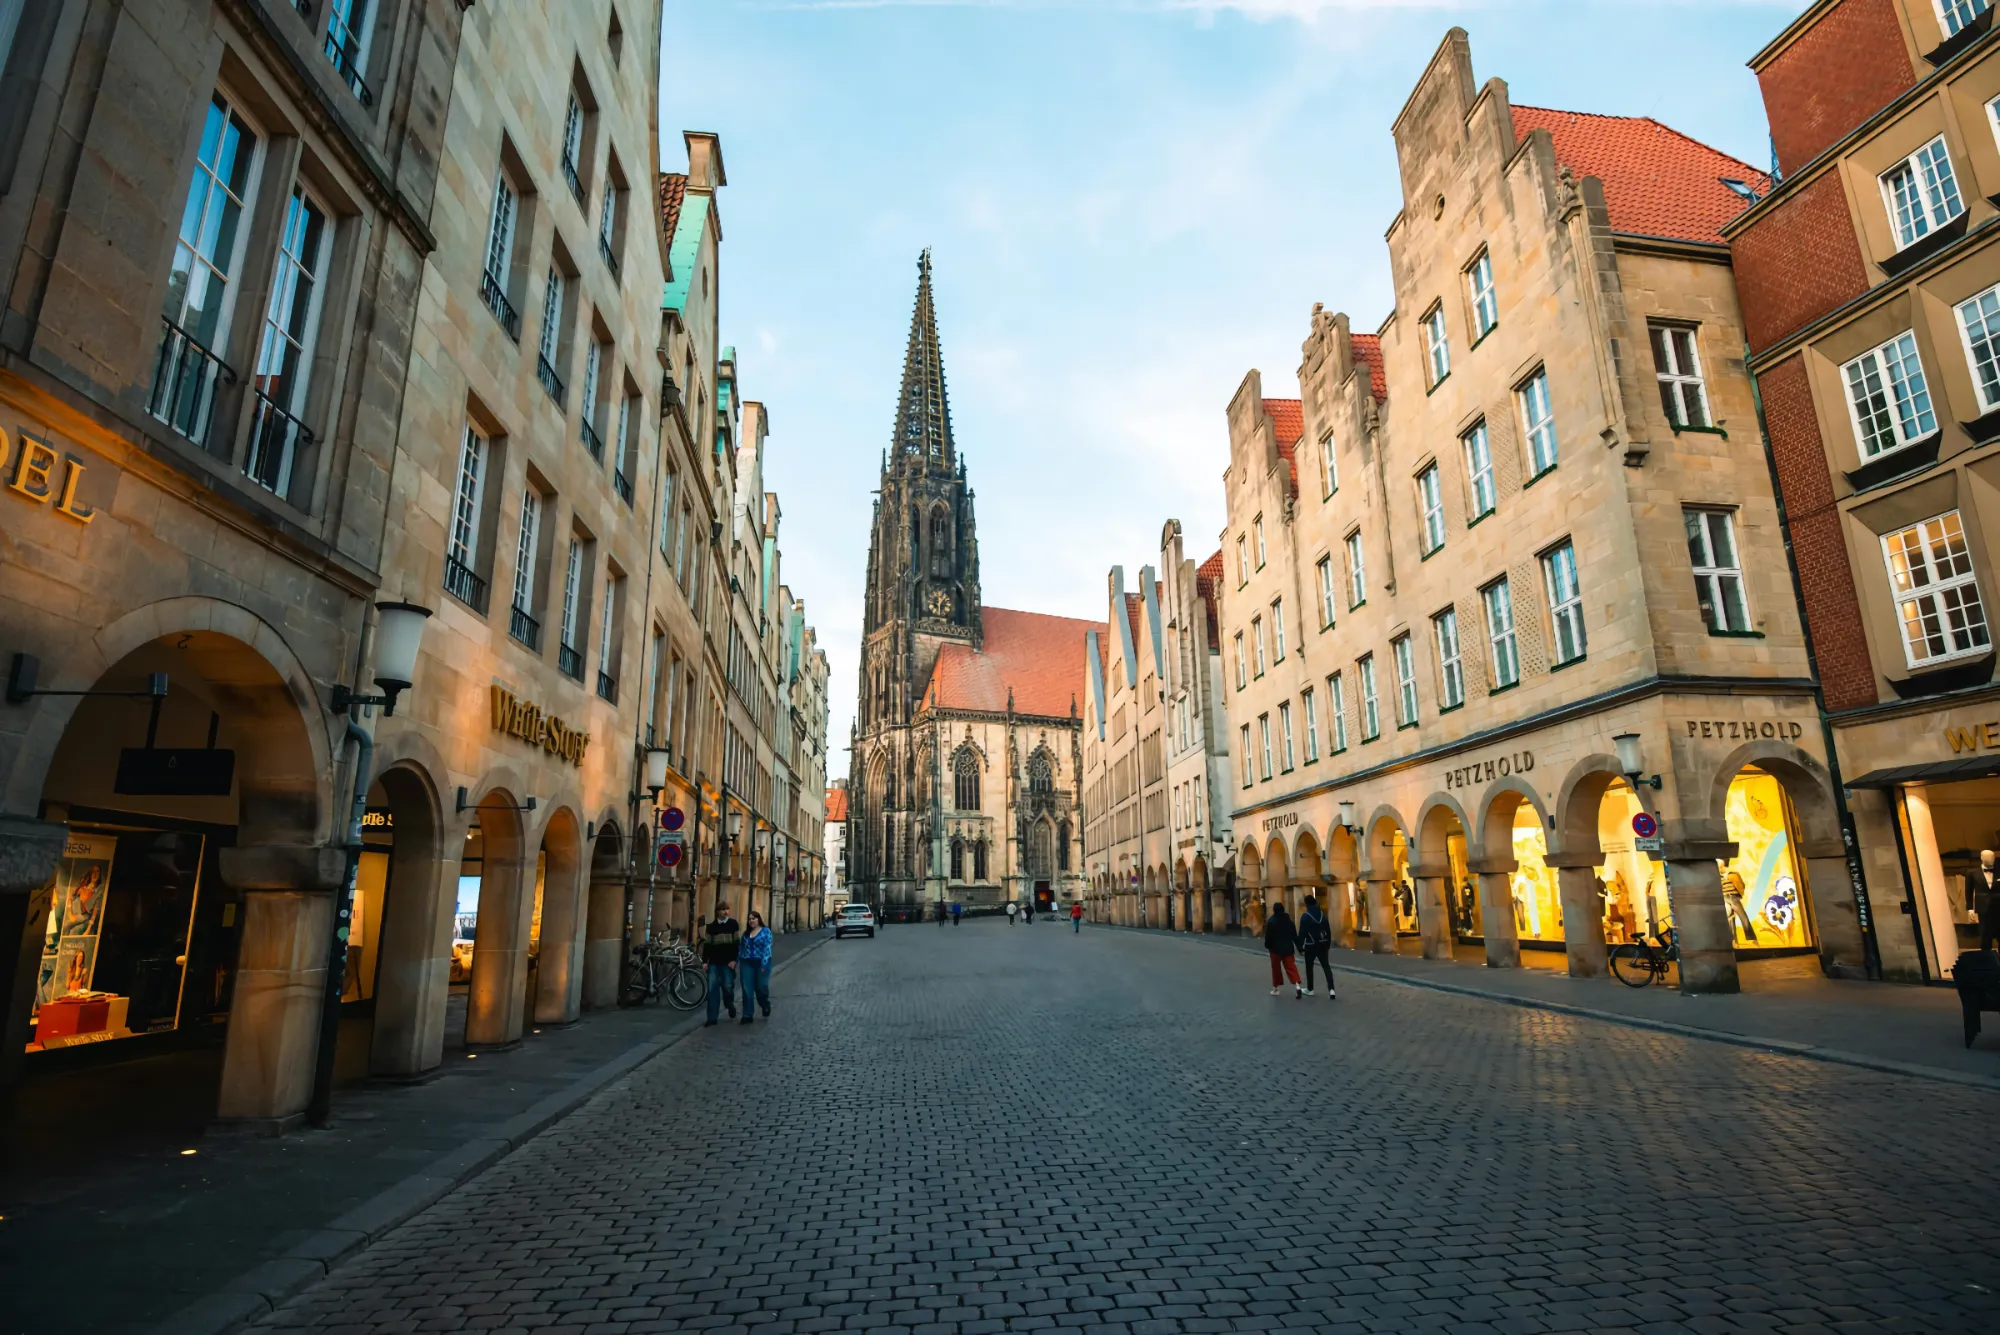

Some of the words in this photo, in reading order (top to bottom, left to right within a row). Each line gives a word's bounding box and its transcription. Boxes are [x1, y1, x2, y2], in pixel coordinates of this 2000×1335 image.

[1686, 720, 1802, 740] PETZHOLD
[1446, 750, 1535, 790] PETZHOLD
[1262, 812, 1298, 832] PETZHOLD
